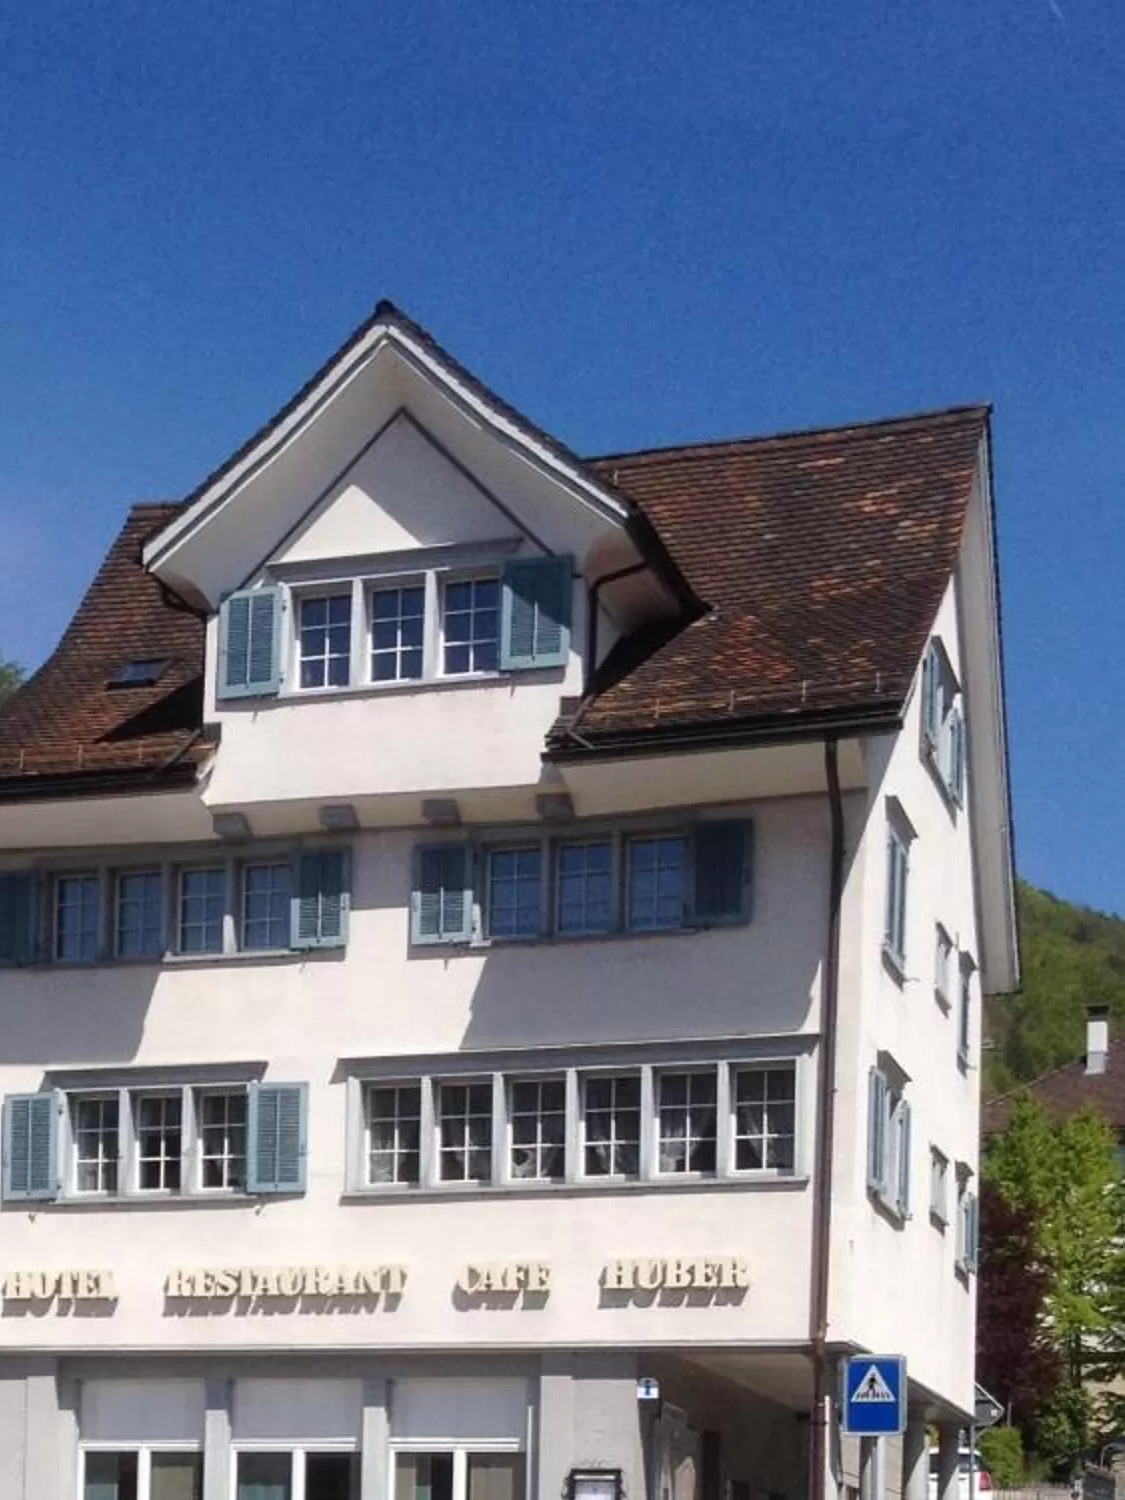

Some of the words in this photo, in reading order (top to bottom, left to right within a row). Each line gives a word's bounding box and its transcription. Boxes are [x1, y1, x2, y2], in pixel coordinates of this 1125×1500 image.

[2, 1269, 119, 1302] HOTEL
[163, 1264, 411, 1299] RESTAURANT
[455, 1257, 554, 1293] CAFE
[602, 1254, 752, 1290] HUBER
